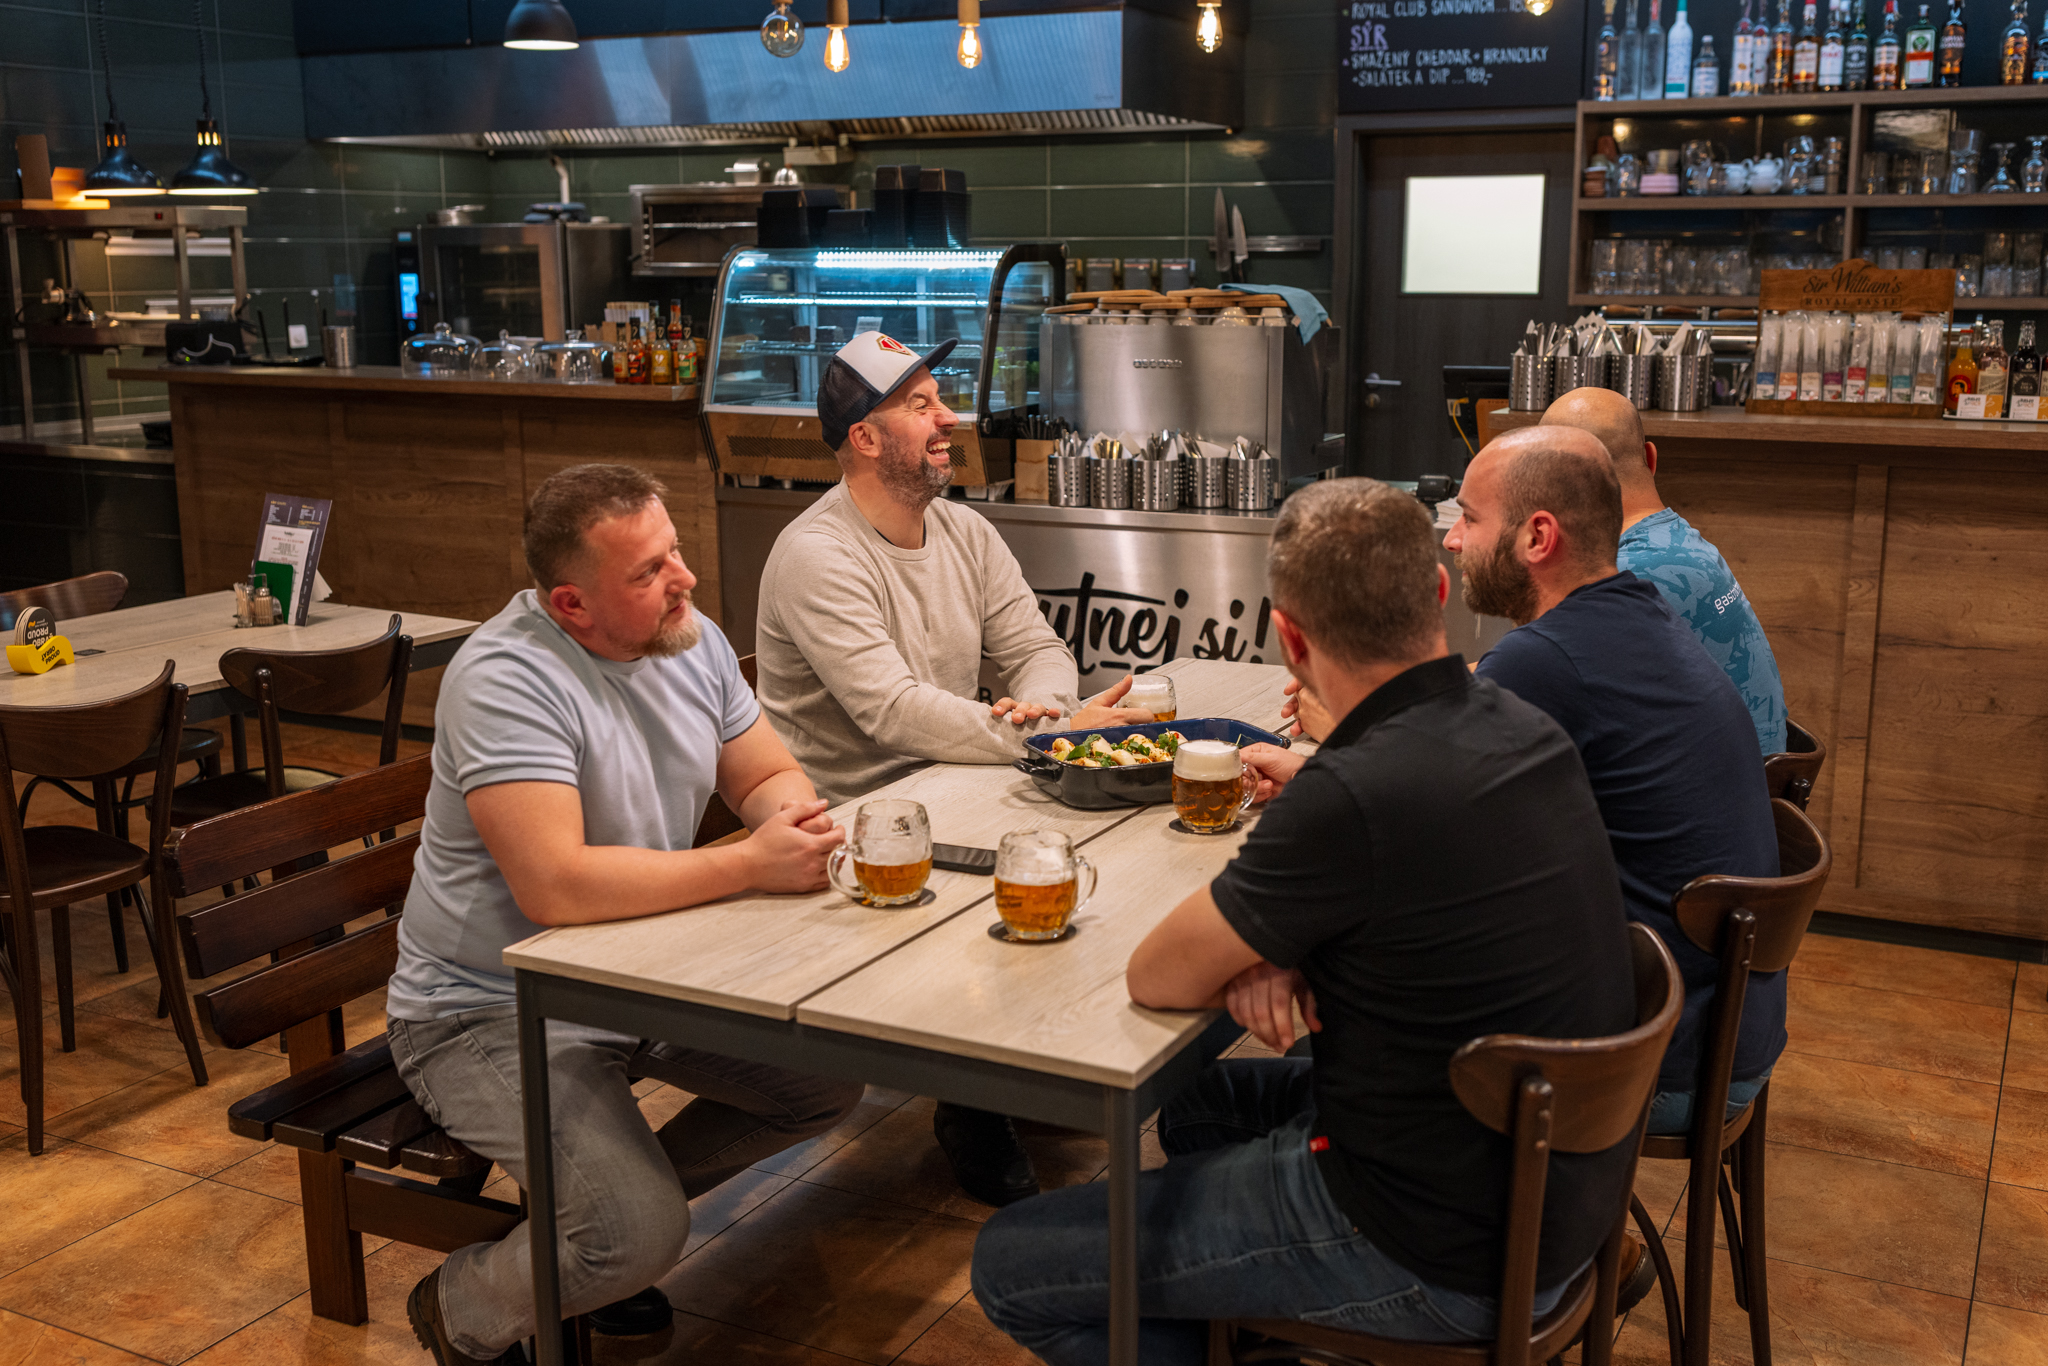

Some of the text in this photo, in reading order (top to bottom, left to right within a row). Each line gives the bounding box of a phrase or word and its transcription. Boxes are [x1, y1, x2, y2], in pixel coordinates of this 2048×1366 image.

[1393, 0, 1427, 17] CLUB
[1414, 69, 1424, 85] A
[1803, 265, 1901, 294] Sir William's
[27, 626, 49, 639] PROUD
